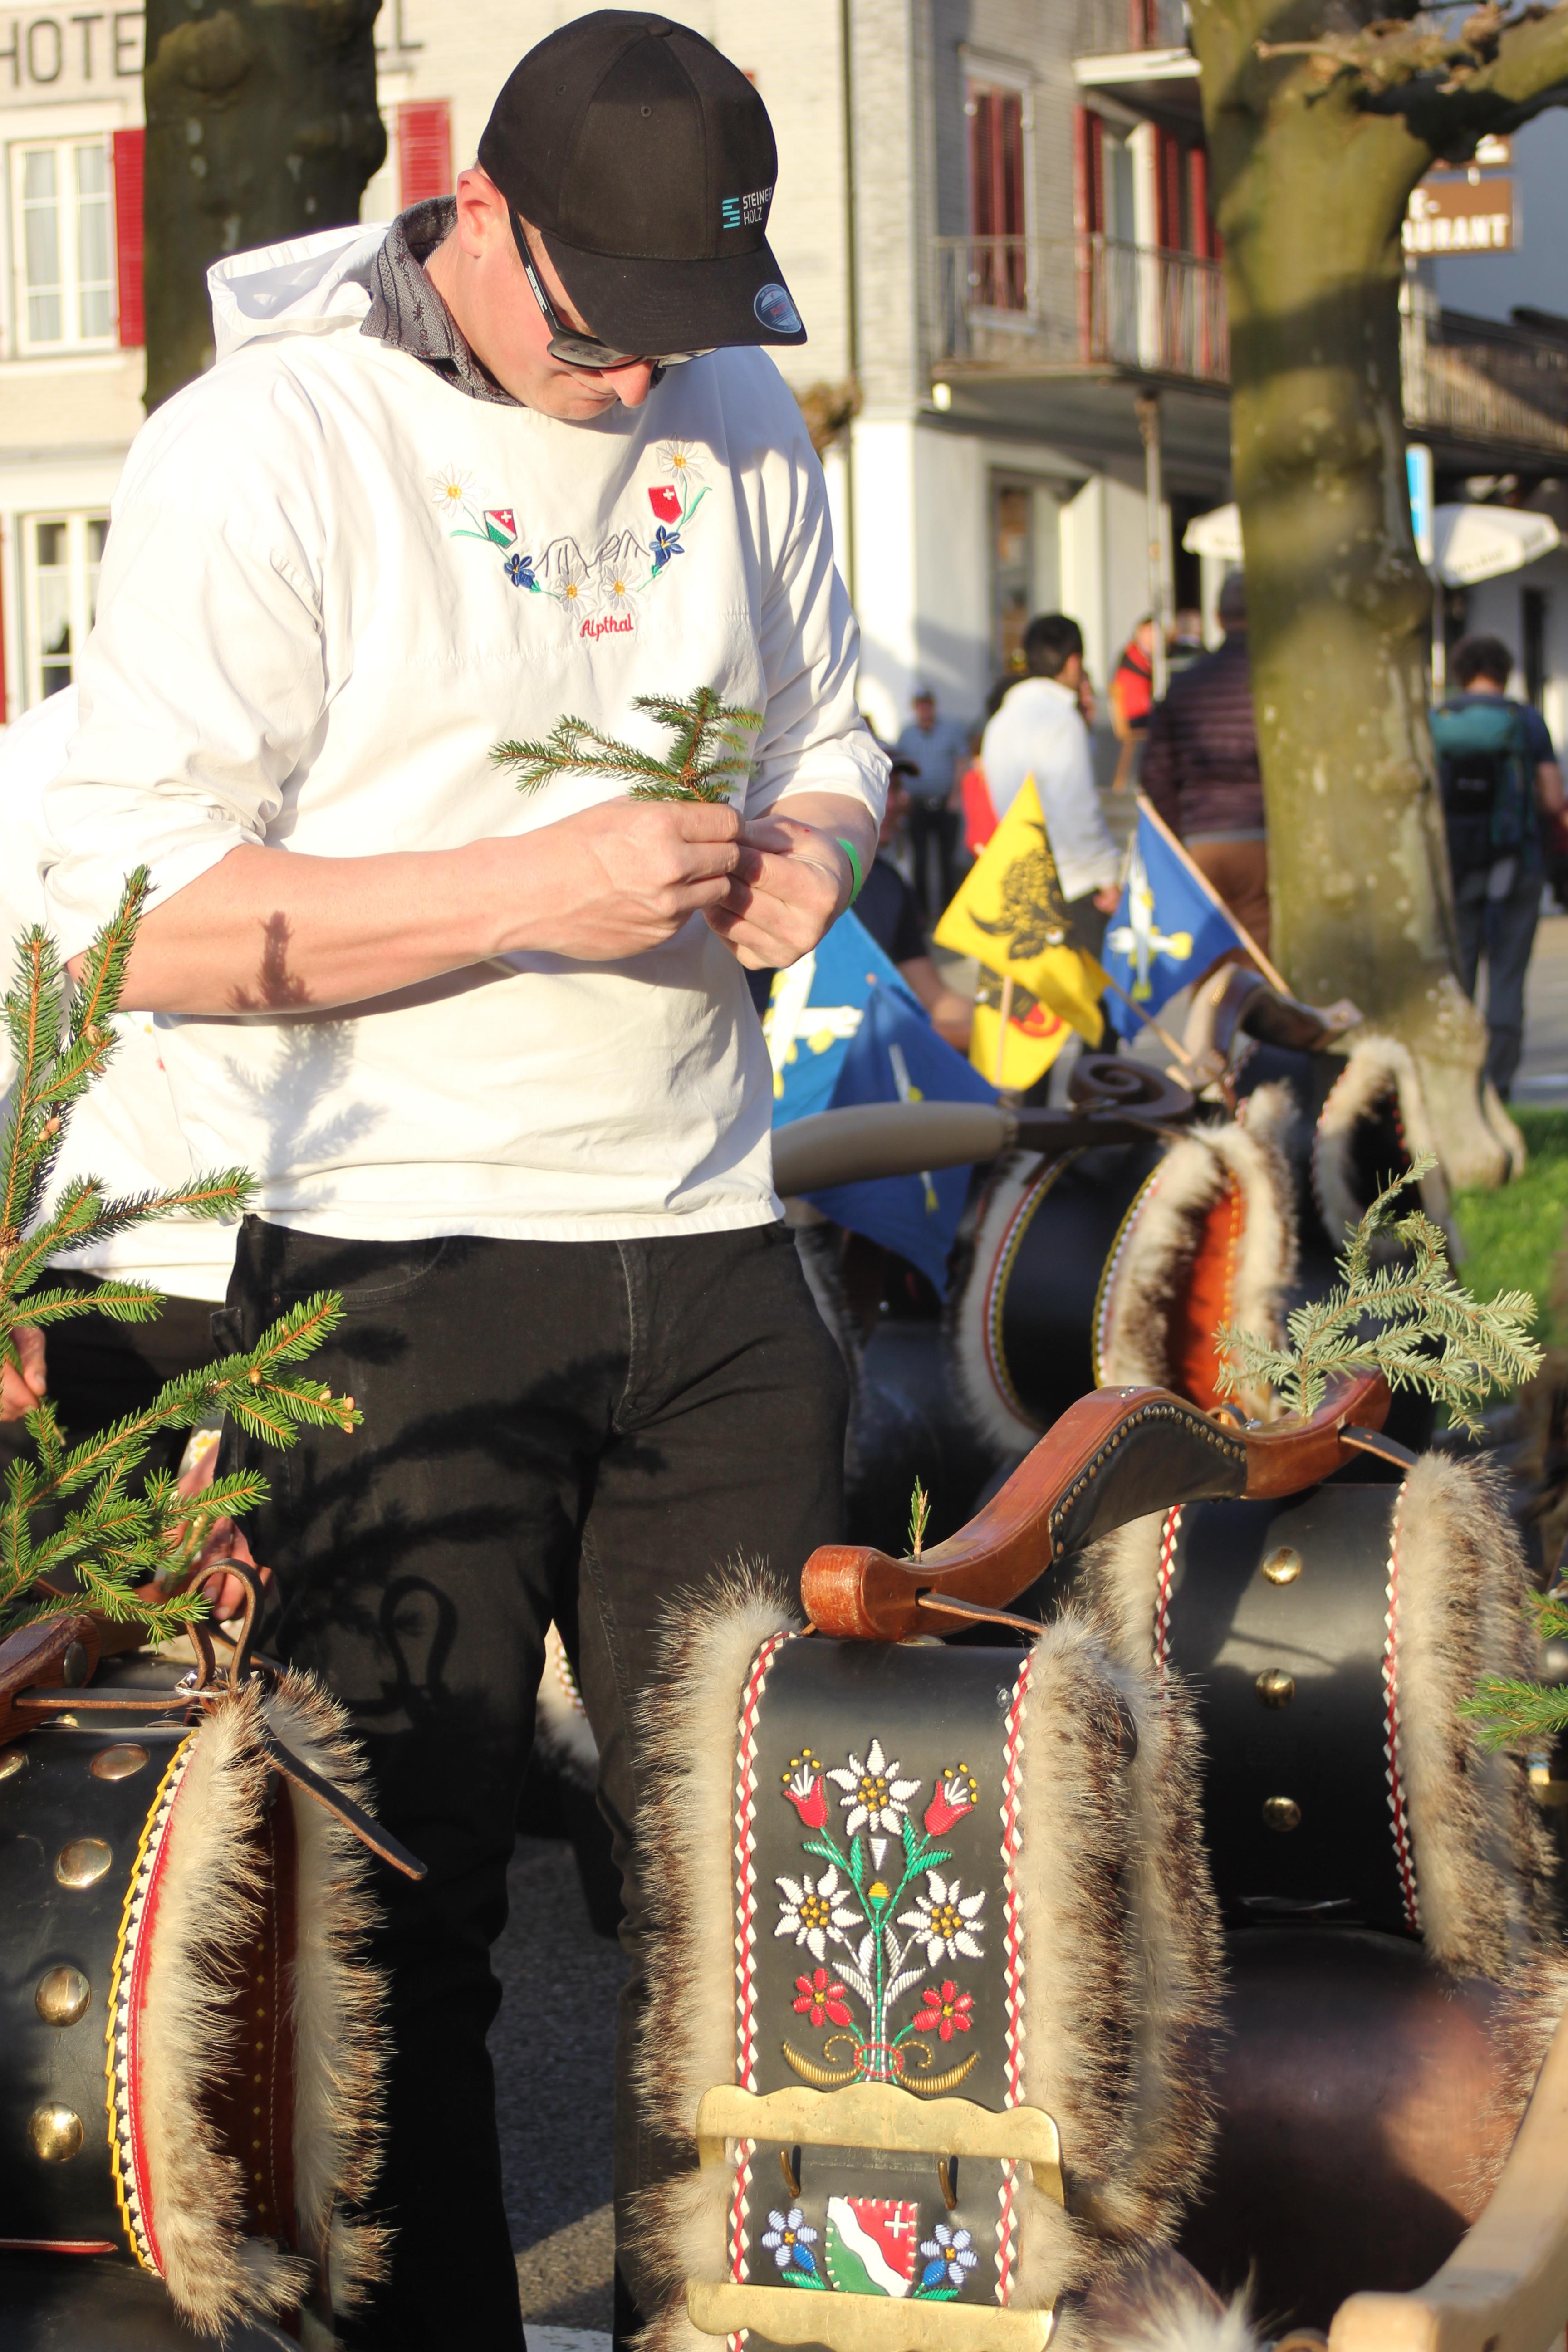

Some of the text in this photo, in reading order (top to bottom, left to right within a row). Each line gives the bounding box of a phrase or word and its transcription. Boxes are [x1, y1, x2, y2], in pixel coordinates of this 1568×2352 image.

[0, 11, 144, 87] HOTE
[744, 206, 762, 225] HOLZ
[580, 613, 634, 642] Alpthal
